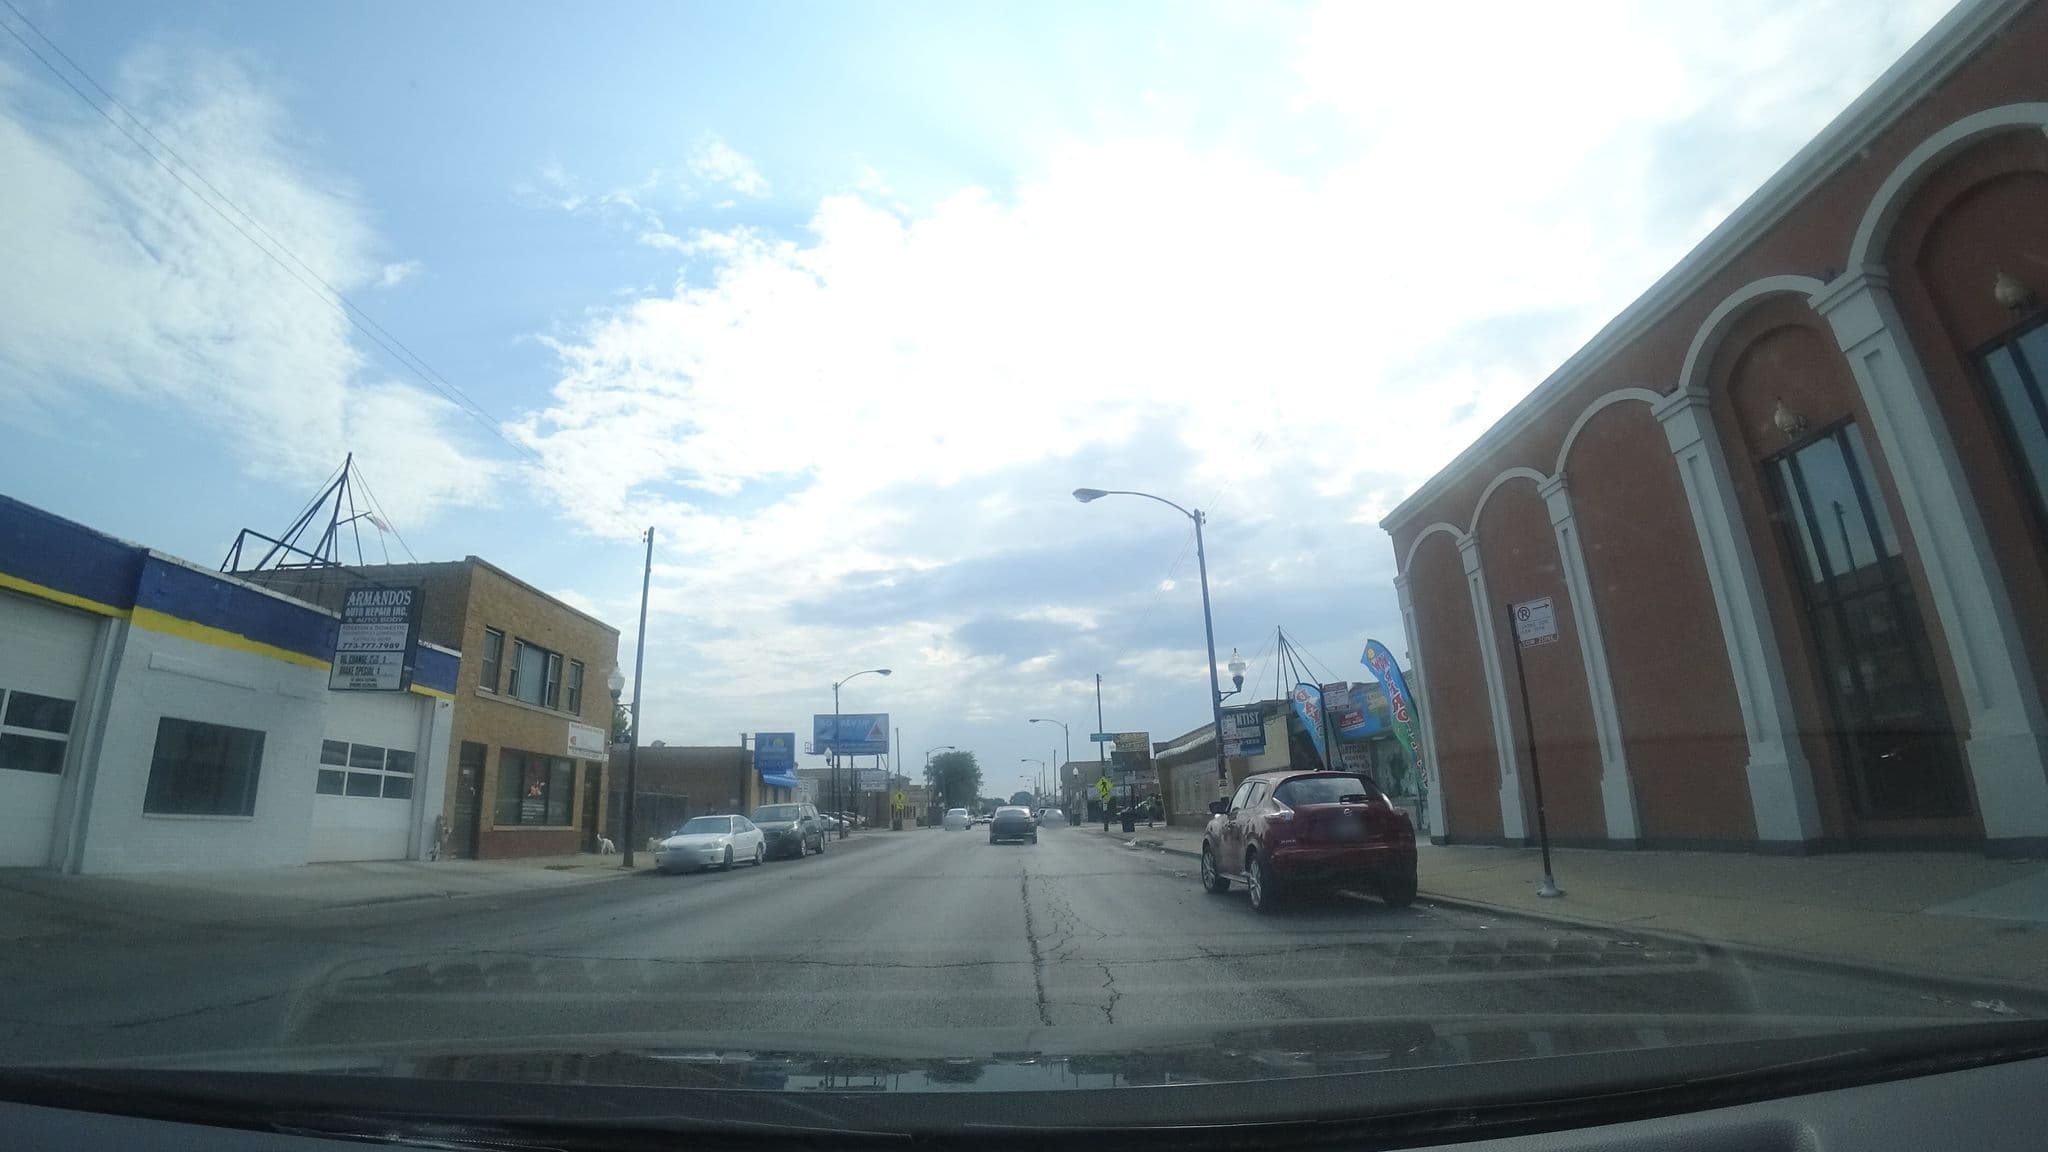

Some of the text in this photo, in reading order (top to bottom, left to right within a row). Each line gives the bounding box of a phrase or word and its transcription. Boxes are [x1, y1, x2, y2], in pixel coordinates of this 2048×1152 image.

[347, 590, 412, 606] ARMANDO'S
[345, 606, 408, 617] AUTO REPAIR INC.
